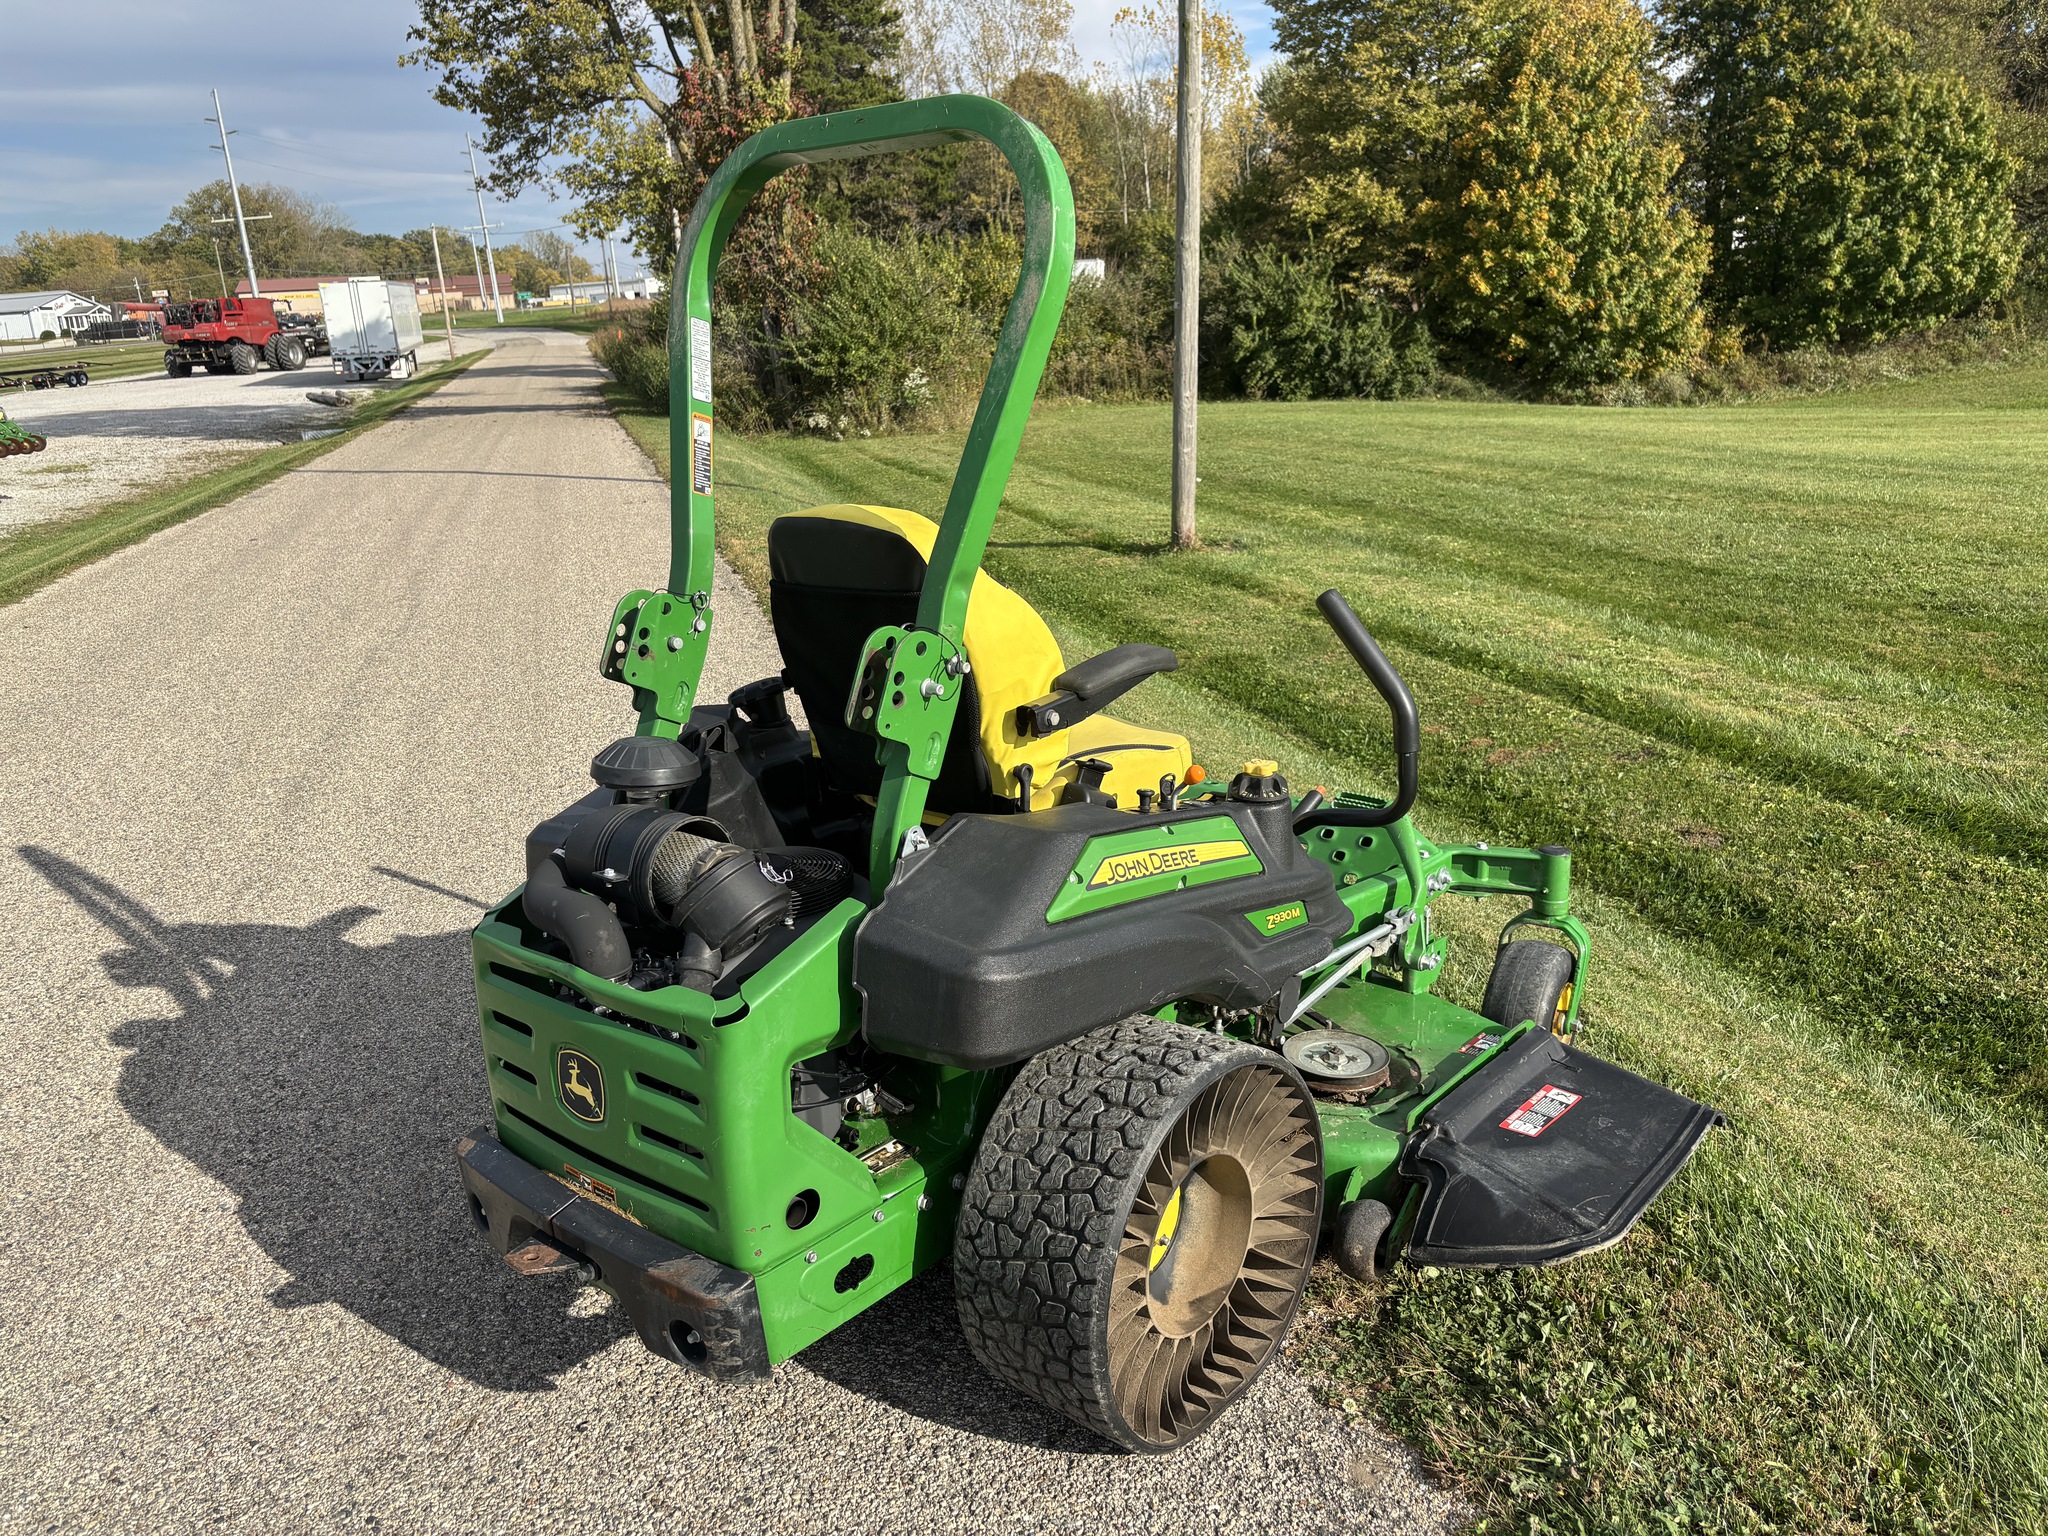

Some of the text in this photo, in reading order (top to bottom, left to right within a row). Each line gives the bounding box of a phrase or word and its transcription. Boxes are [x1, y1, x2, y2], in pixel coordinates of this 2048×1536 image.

[1107, 849, 1200, 882] JOHN DEERE
[1265, 906, 1301, 930] Z930M
